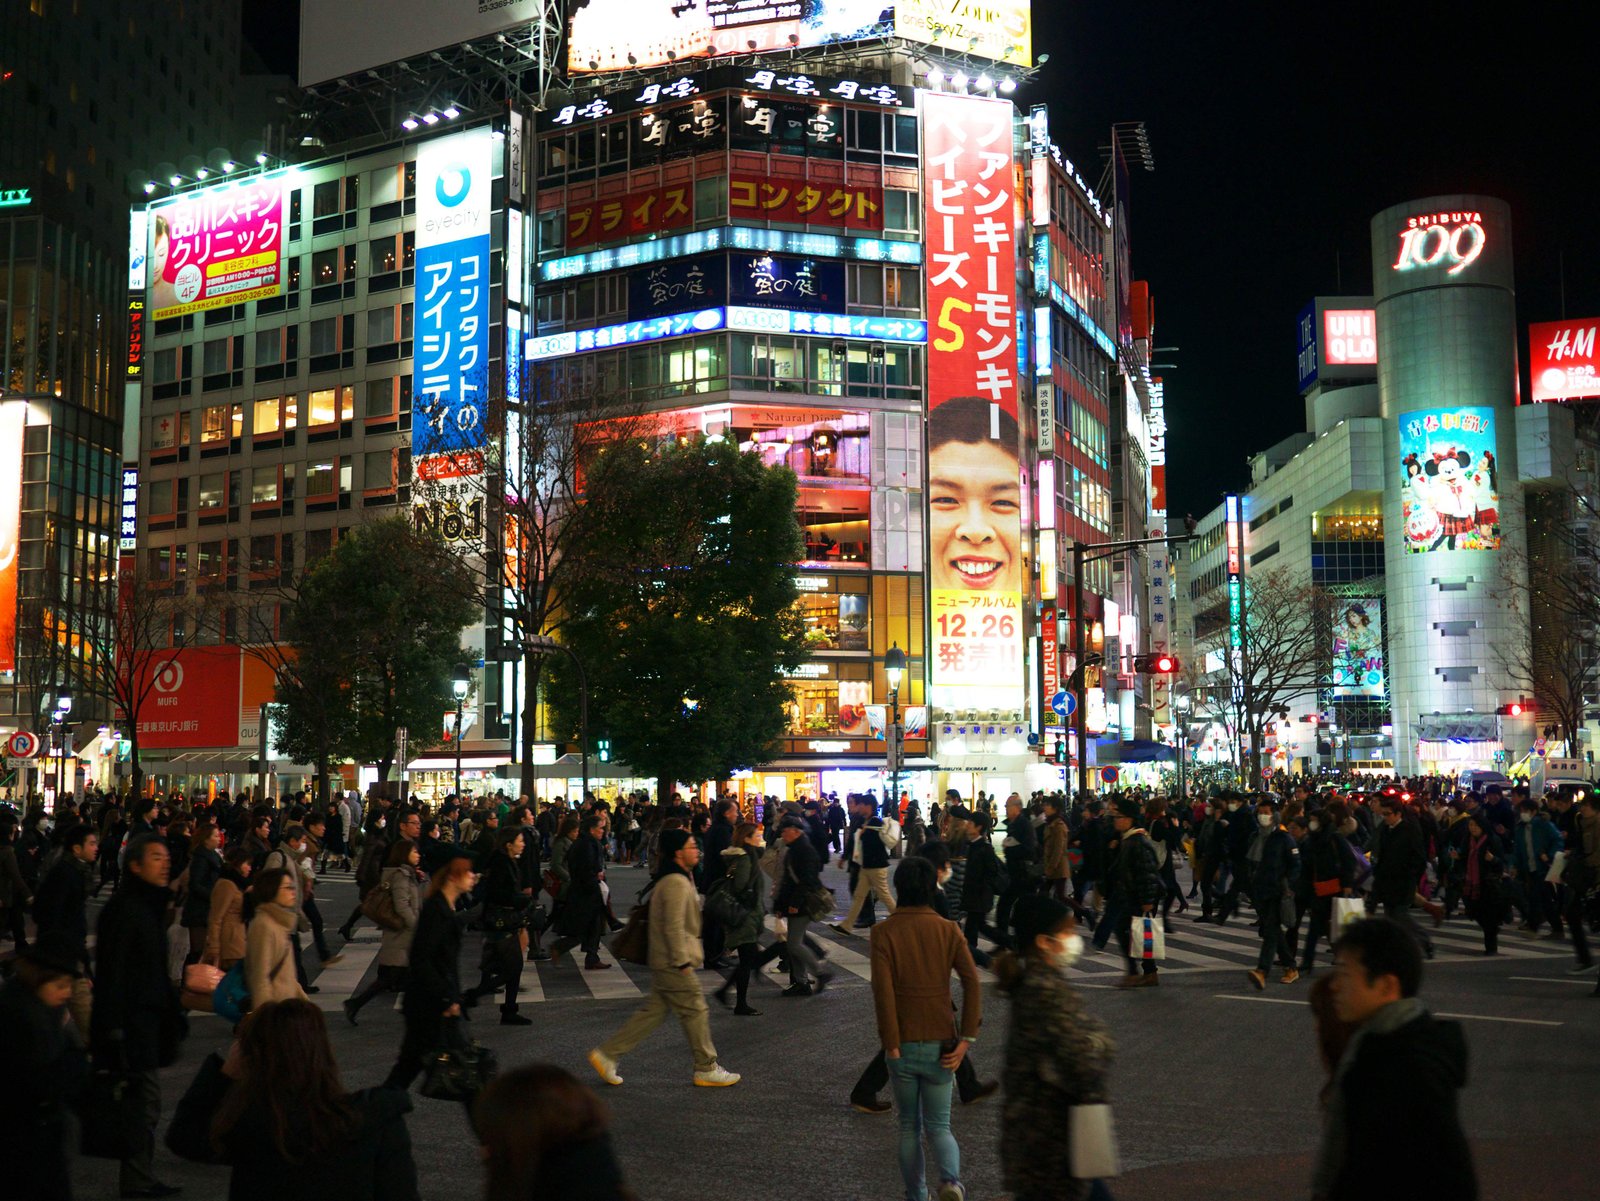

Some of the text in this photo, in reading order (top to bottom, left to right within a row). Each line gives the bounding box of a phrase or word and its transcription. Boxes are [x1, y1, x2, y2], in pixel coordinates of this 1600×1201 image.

[643, 109, 721, 146] 月の宴
[745, 108, 836, 142] 月の宴
[511, 127, 520, 187] 大外ビル
[172, 190, 281, 240] 品川スキン
[569, 188, 689, 238] プライス
[731, 181, 878, 219] コンタクト
[426, 208, 480, 235] eyecity
[1408, 211, 1483, 229] SHIBUYA
[172, 219, 279, 269] クリニック
[1393, 222, 1486, 275] 109
[181, 286, 195, 299] 4F
[972, 115, 1013, 440] ファンキーモンキー
[129, 313, 142, 363] アメリカン
[578, 318, 689, 350] 英会話イーオン
[793, 312, 922, 338] 英会話イーオン
[933, 297, 972, 352] 5
[1301, 313, 1312, 348] THE
[1330, 316, 1370, 336] UNI
[422, 261, 453, 435] アイシティ
[457, 255, 480, 431] コンタクトの
[1331, 338, 1375, 361] QLO
[1546, 327, 1597, 361] H&M
[127, 365, 140, 374] 8F
[1298, 341, 1316, 382] PRIME
[766, 412, 806, 422] Natural
[1040, 389, 1049, 446] 渋谷駅前ビル
[122, 540, 134, 548] 5F
[937, 596, 1017, 609] ニューアルバム
[937, 613, 1015, 638] 12.26
[1153, 559, 1167, 711] 洋装生地 マナン
[938, 643, 1016, 673] 発売!!
[157, 697, 178, 706] MUFG
[135, 720, 199, 733] 三菱東京UFJ銀行
